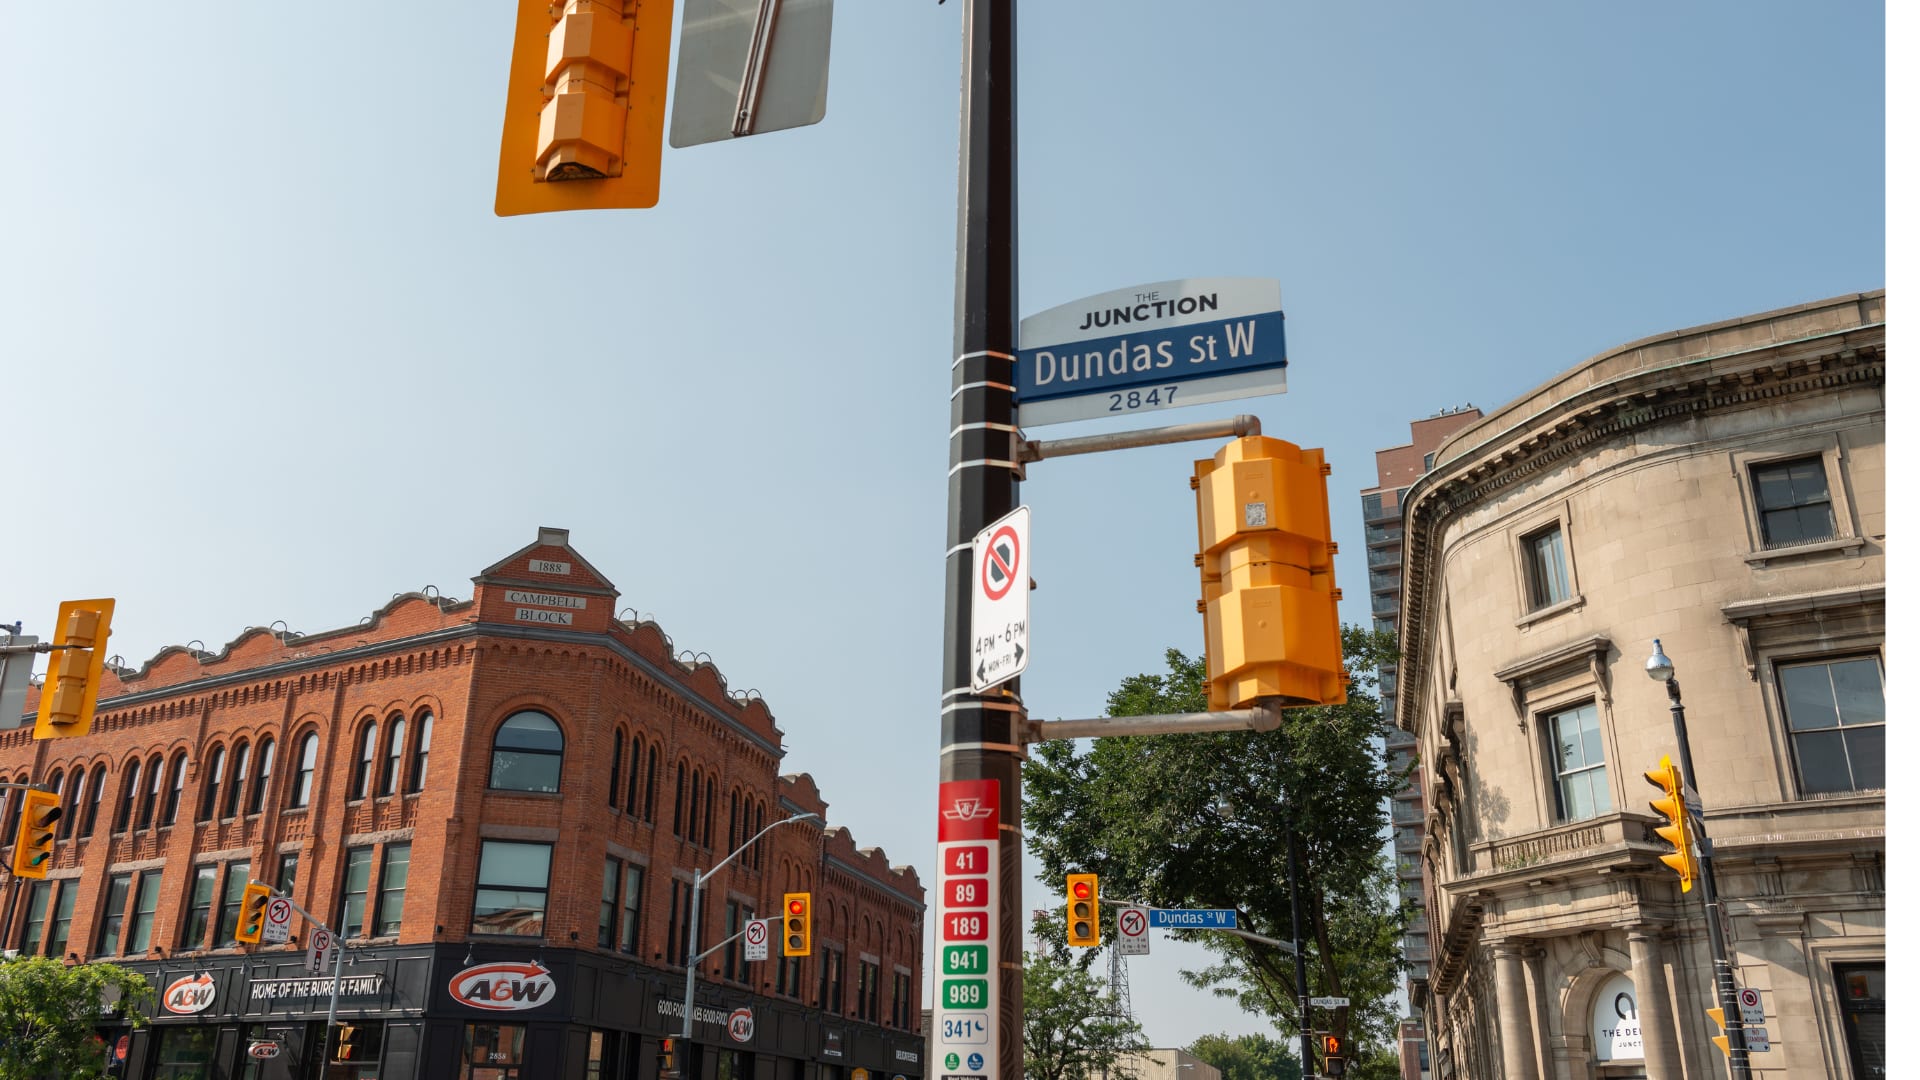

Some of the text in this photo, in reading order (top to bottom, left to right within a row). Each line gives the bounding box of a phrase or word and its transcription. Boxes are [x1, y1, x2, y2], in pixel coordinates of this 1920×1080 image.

[1135, 291, 1159, 303] THE
[1079, 293, 1218, 330] JUNCTION
[1035, 320, 1256, 386] Dundas St W
[1109, 386, 1178, 411] 2847
[539, 562, 562, 572] 1888
[510, 592, 580, 608] CAMPBELL
[519, 609, 568, 624] BLOCK
[956, 852, 974, 869] 41
[956, 884, 975, 902] 89
[951, 917, 980, 936] 189
[1159, 911, 1204, 924] Dundas
[1215, 911, 1226, 924] W
[950, 950, 978, 969] 941
[170, 988, 212, 1007] A&W
[252, 978, 383, 999] HOME OF THE BURGR FAMILY
[463, 979, 550, 1002] A&W
[950, 984, 980, 1004] 989
[657, 1000, 673, 1015] GOOD
[702, 1008, 716, 1023] GOOD
[715, 1011, 728, 1026] FOOD
[733, 1020, 752, 1035] A&W
[944, 1020, 971, 1038] 341
[1602, 1029, 1622, 1038] THE
